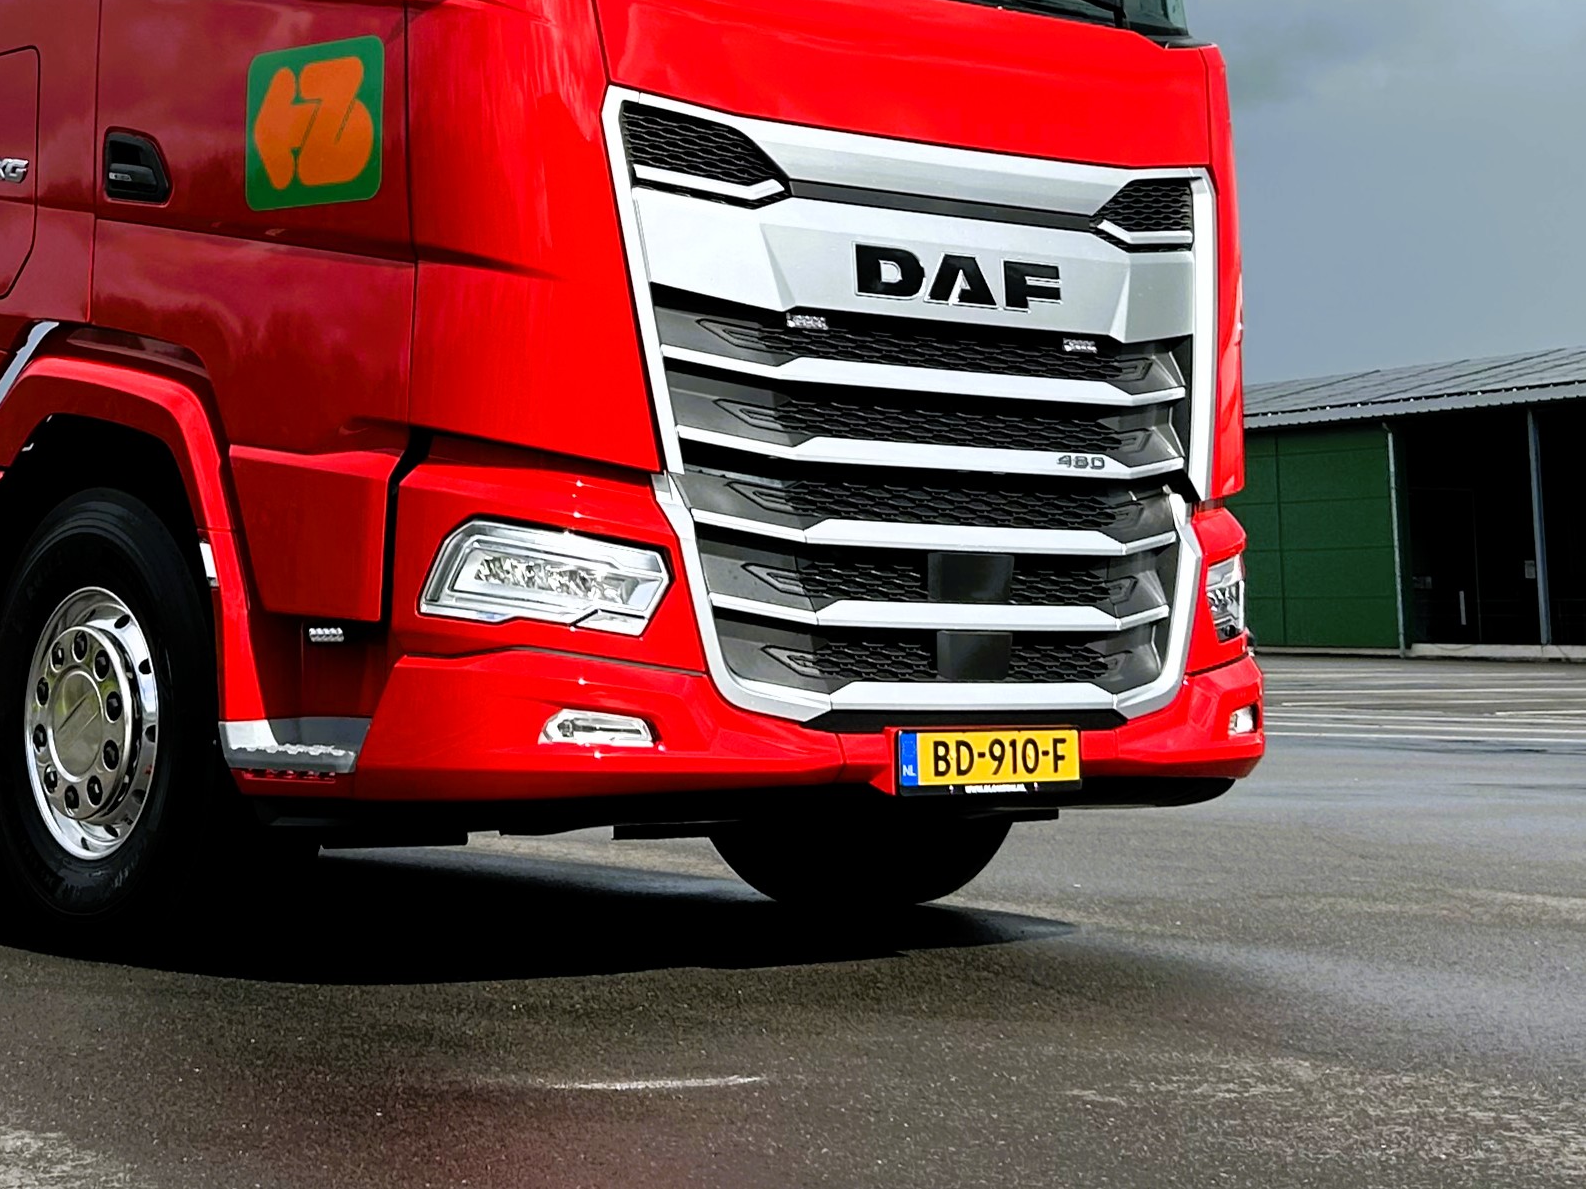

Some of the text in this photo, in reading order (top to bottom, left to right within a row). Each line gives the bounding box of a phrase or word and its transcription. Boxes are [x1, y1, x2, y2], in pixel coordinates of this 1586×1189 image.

[852, 241, 1063, 313] DAF
[1056, 454, 1106, 471] 480
[902, 764, 917, 777] NL
[932, 737, 1067, 778] BD-910-F
